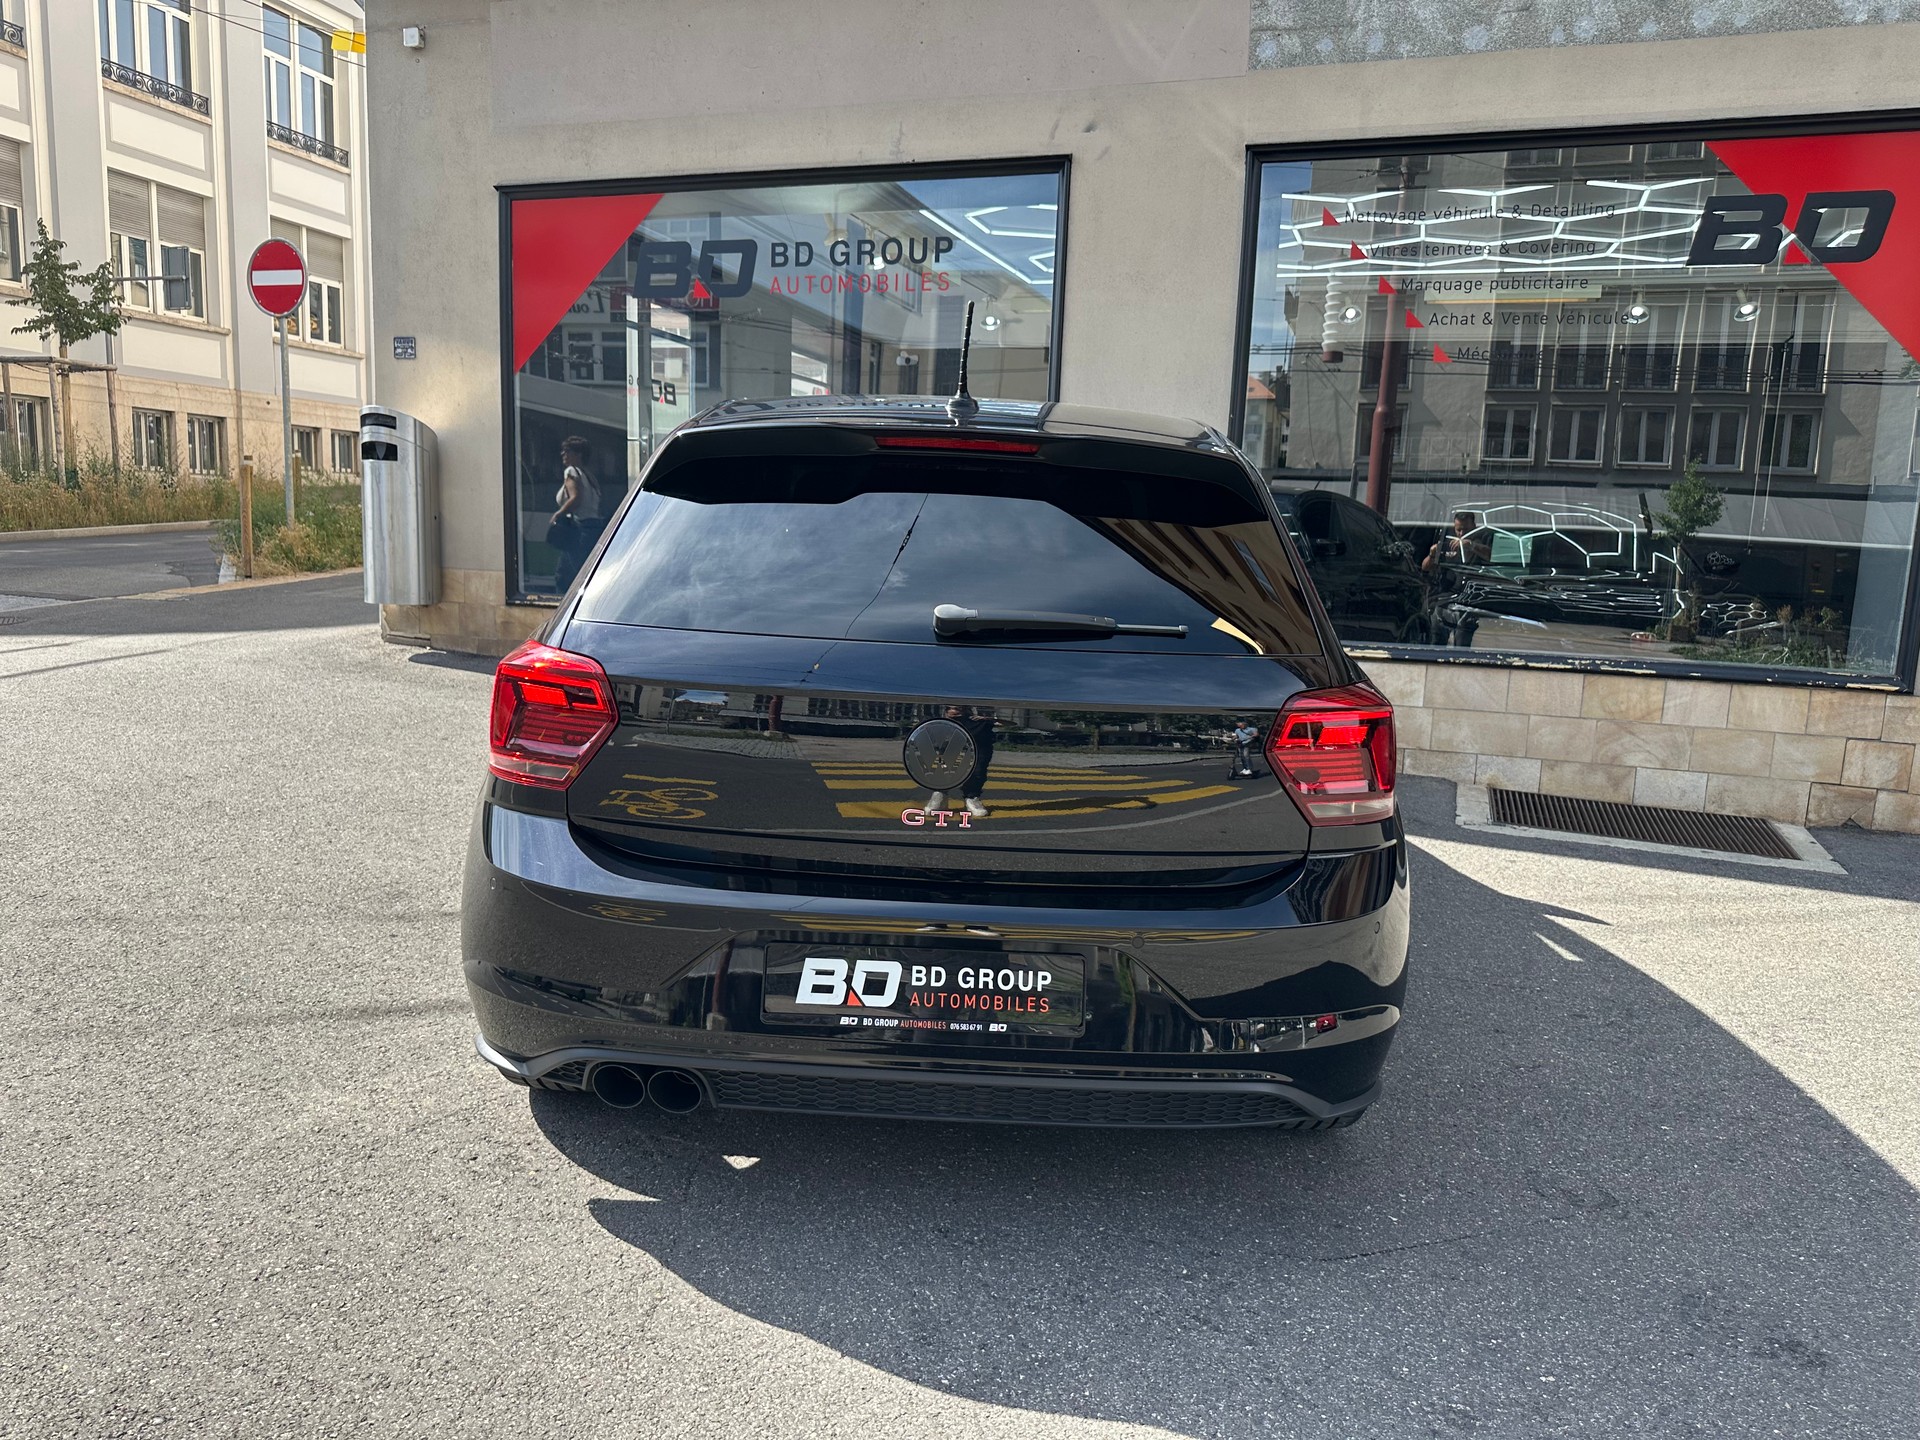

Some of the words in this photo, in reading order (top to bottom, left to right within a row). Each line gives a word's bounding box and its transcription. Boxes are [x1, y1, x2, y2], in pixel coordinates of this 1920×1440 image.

[1344, 209, 1427, 225] Nettoyage
[1433, 206, 1504, 221] véhicule
[1511, 204, 1523, 219] &
[1531, 202, 1616, 218] Detailling
[1685, 189, 1897, 266] BD
[770, 241, 814, 268] BD
[829, 236, 955, 267] GROUP
[1369, 243, 1418, 257] Vitres
[1425, 240, 1492, 257] teintées
[1499, 240, 1511, 254] &
[1518, 240, 1596, 256] Covering
[633, 238, 758, 298] BD
[769, 271, 951, 295] AUTOMOBILES
[1400, 278, 1484, 295] Marquage
[1489, 275, 1589, 295] publicitaire
[1428, 312, 1476, 326] Achat
[1482, 312, 1494, 326] &
[1501, 311, 1549, 326] Vente
[1555, 310, 1640, 326] véhicules
[901, 808, 972, 828] GTI
[795, 957, 903, 1008] BD
[911, 965, 947, 987] BD
[957, 966, 1053, 992] GROUP
[909, 991, 1051, 1013] AUTOMOBILES
[862, 1017, 873, 1026] BD
[874, 1018, 899, 1027] GROUP
[900, 1020, 947, 1030] AUTOMOBILES
[950, 1022, 960, 1030] 076
